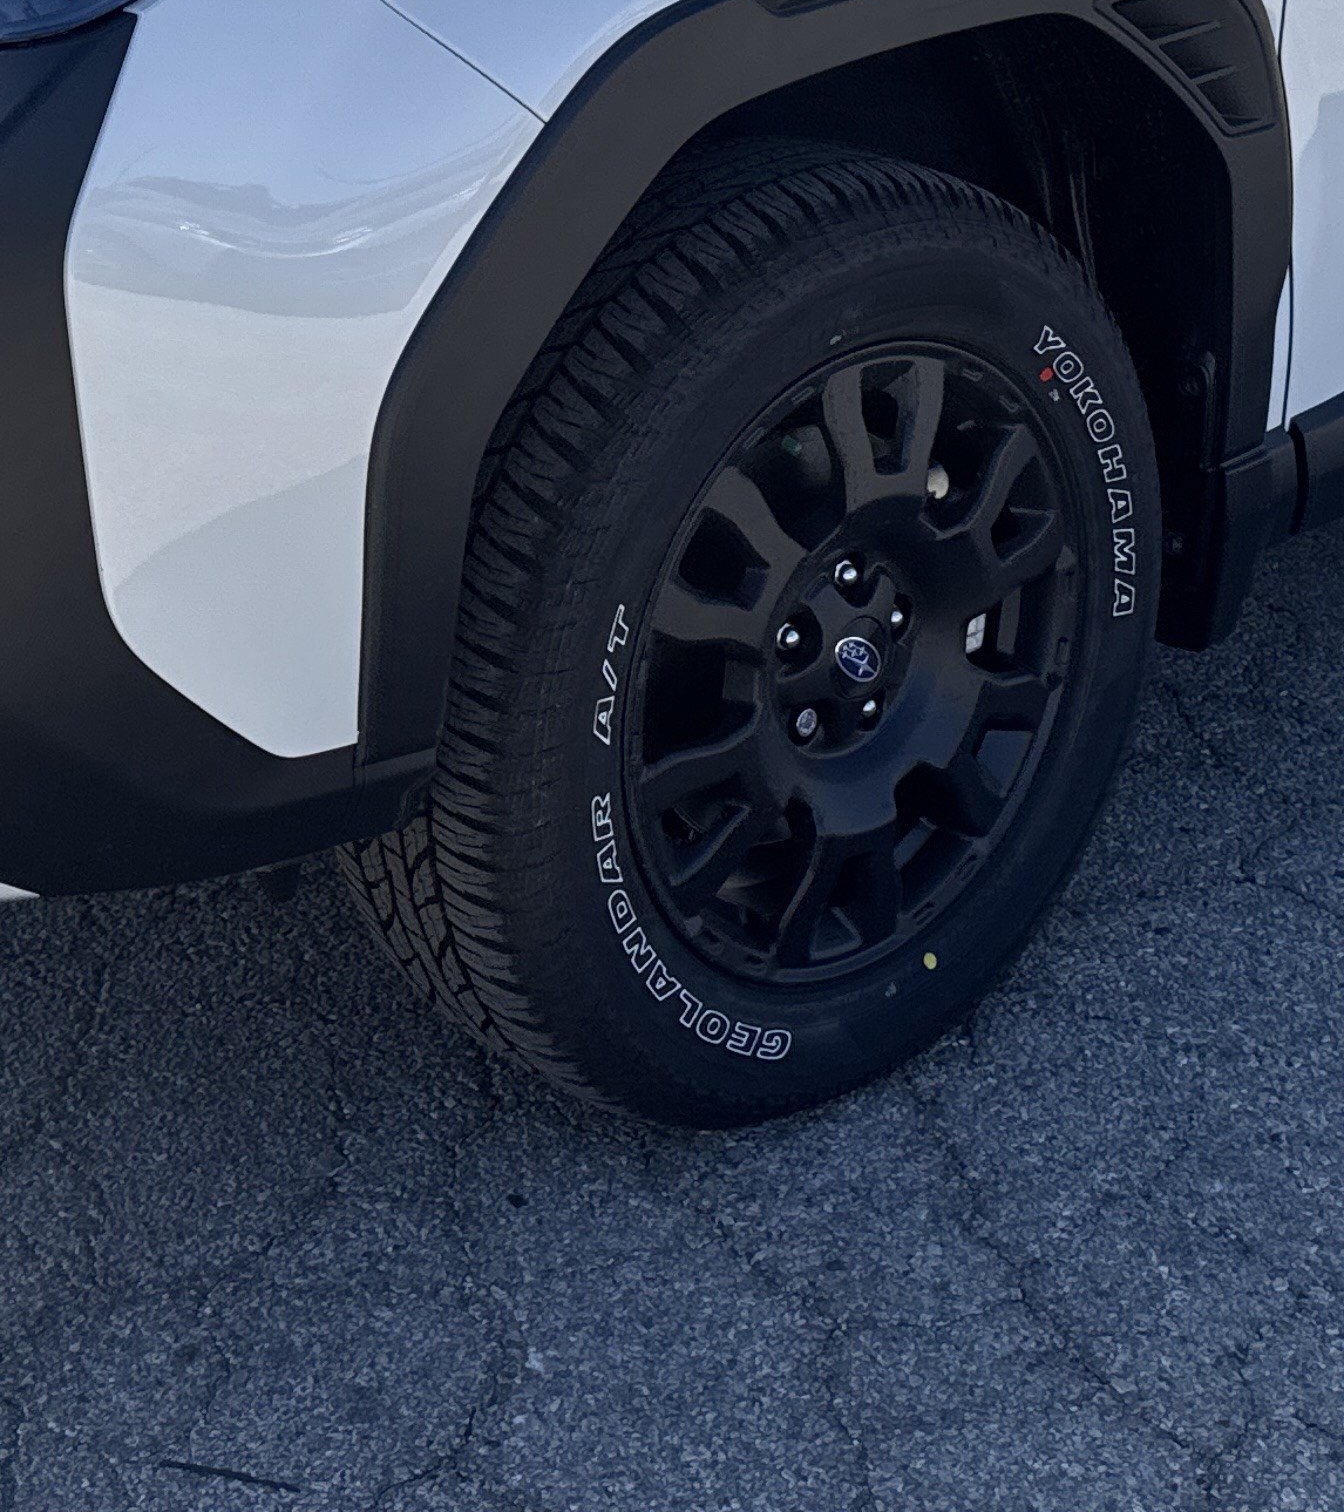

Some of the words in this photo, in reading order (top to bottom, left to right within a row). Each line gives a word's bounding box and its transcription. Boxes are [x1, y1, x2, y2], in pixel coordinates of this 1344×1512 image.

[1032, 324, 1137, 617] YOKOHAMA
[592, 603, 630, 746] A/T
[591, 792, 792, 1061] GEOLANDAR
